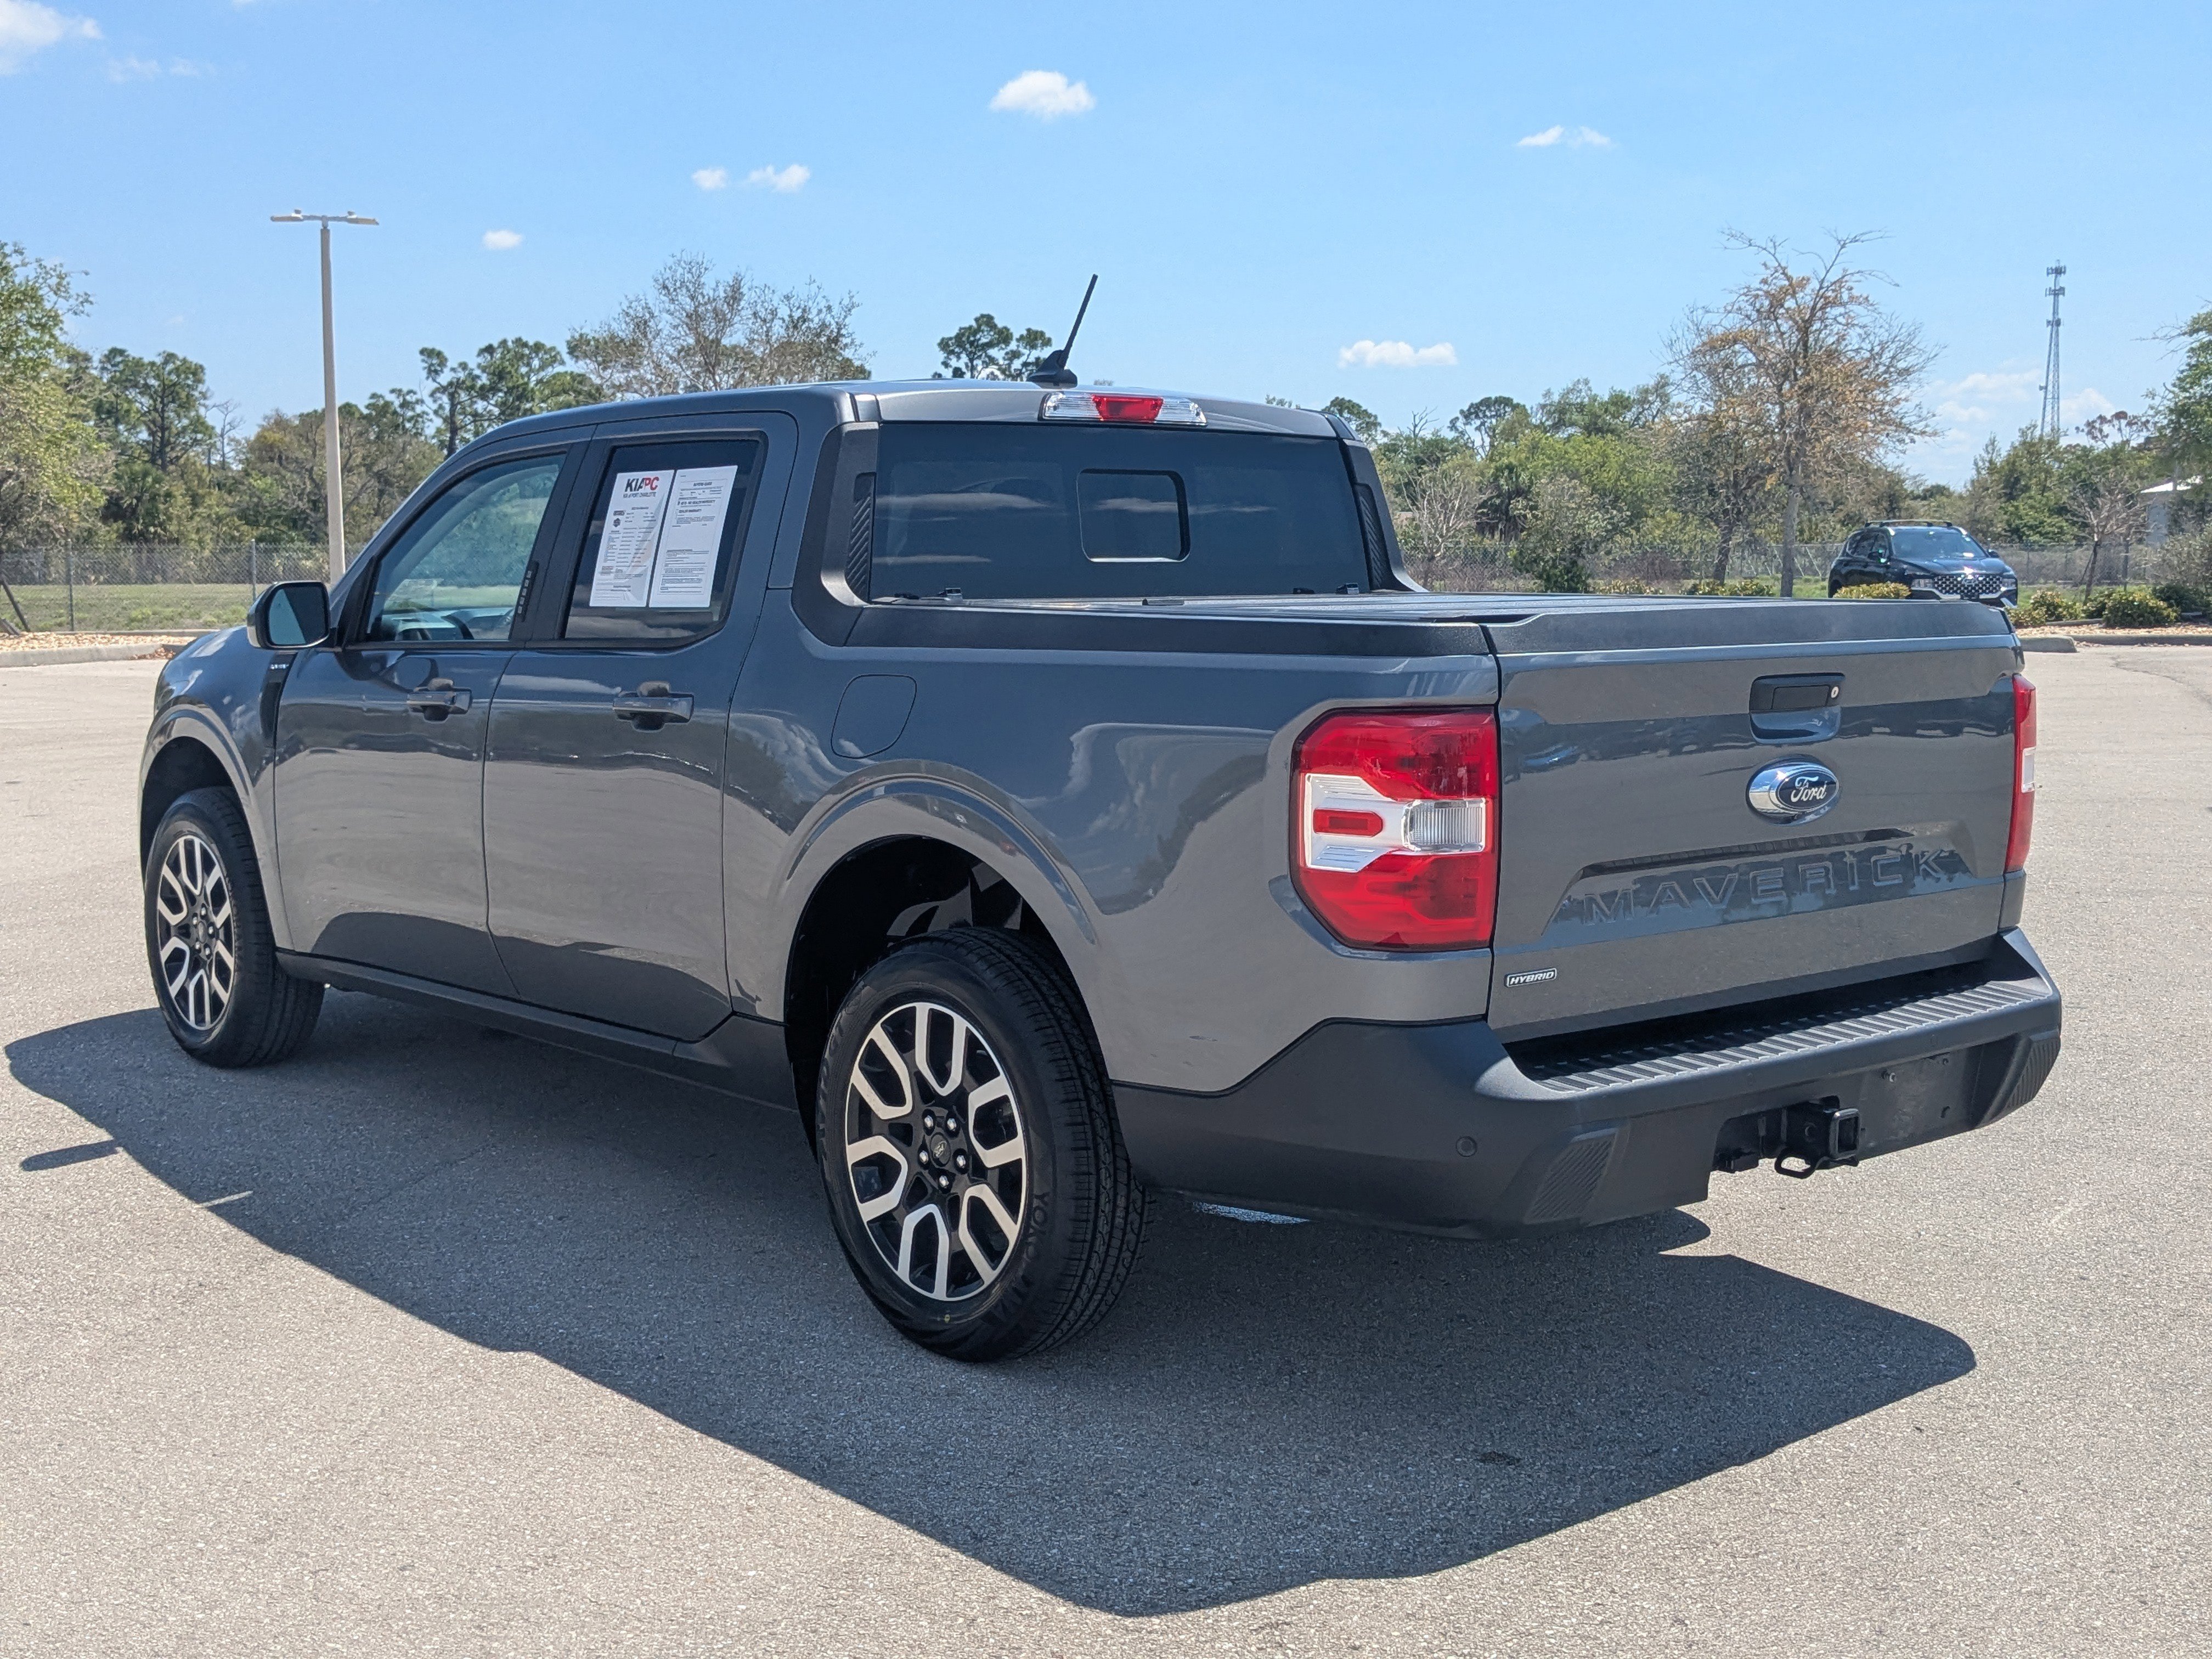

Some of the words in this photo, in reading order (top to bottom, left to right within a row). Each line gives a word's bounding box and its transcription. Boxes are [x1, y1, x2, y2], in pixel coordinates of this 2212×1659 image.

[1790, 776, 1827, 803] Ford
[1583, 848, 1954, 926] MAVERICK
[1509, 971, 1555, 985] HYBRID
